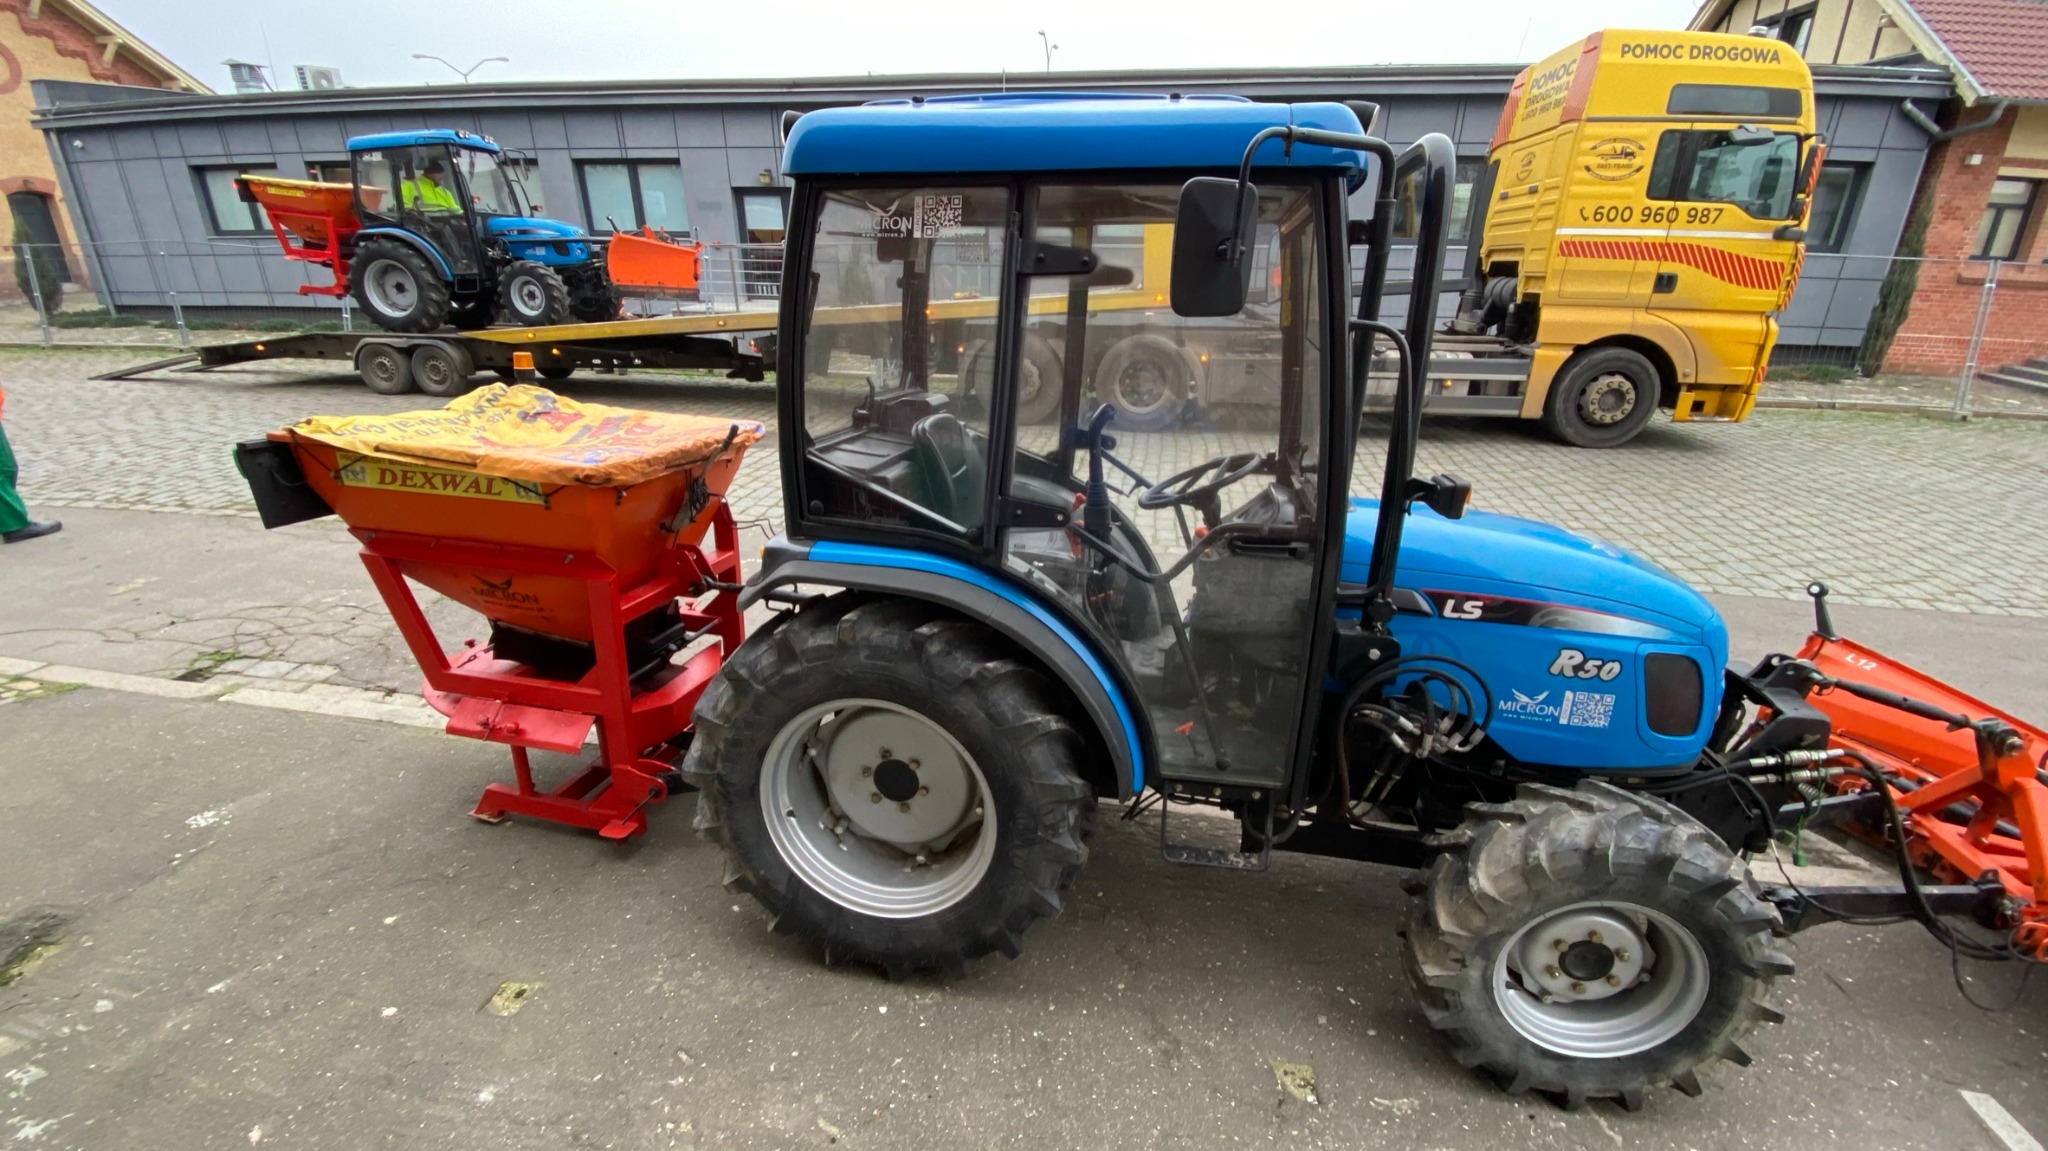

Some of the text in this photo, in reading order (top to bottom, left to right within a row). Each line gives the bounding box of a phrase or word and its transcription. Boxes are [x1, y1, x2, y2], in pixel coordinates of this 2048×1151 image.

[1620, 43, 1781, 65] POMOC DROGOWA
[1530, 58, 1577, 94] POMOC
[1525, 81, 1570, 109] DROGOWA
[856, 216, 913, 230] MICRON
[1592, 205, 1724, 224] 600 960 987
[377, 467, 503, 496] DEXWAL
[1443, 598, 1484, 620] LS
[1550, 649, 1622, 681] R50
[1498, 700, 1560, 717] MICRON
